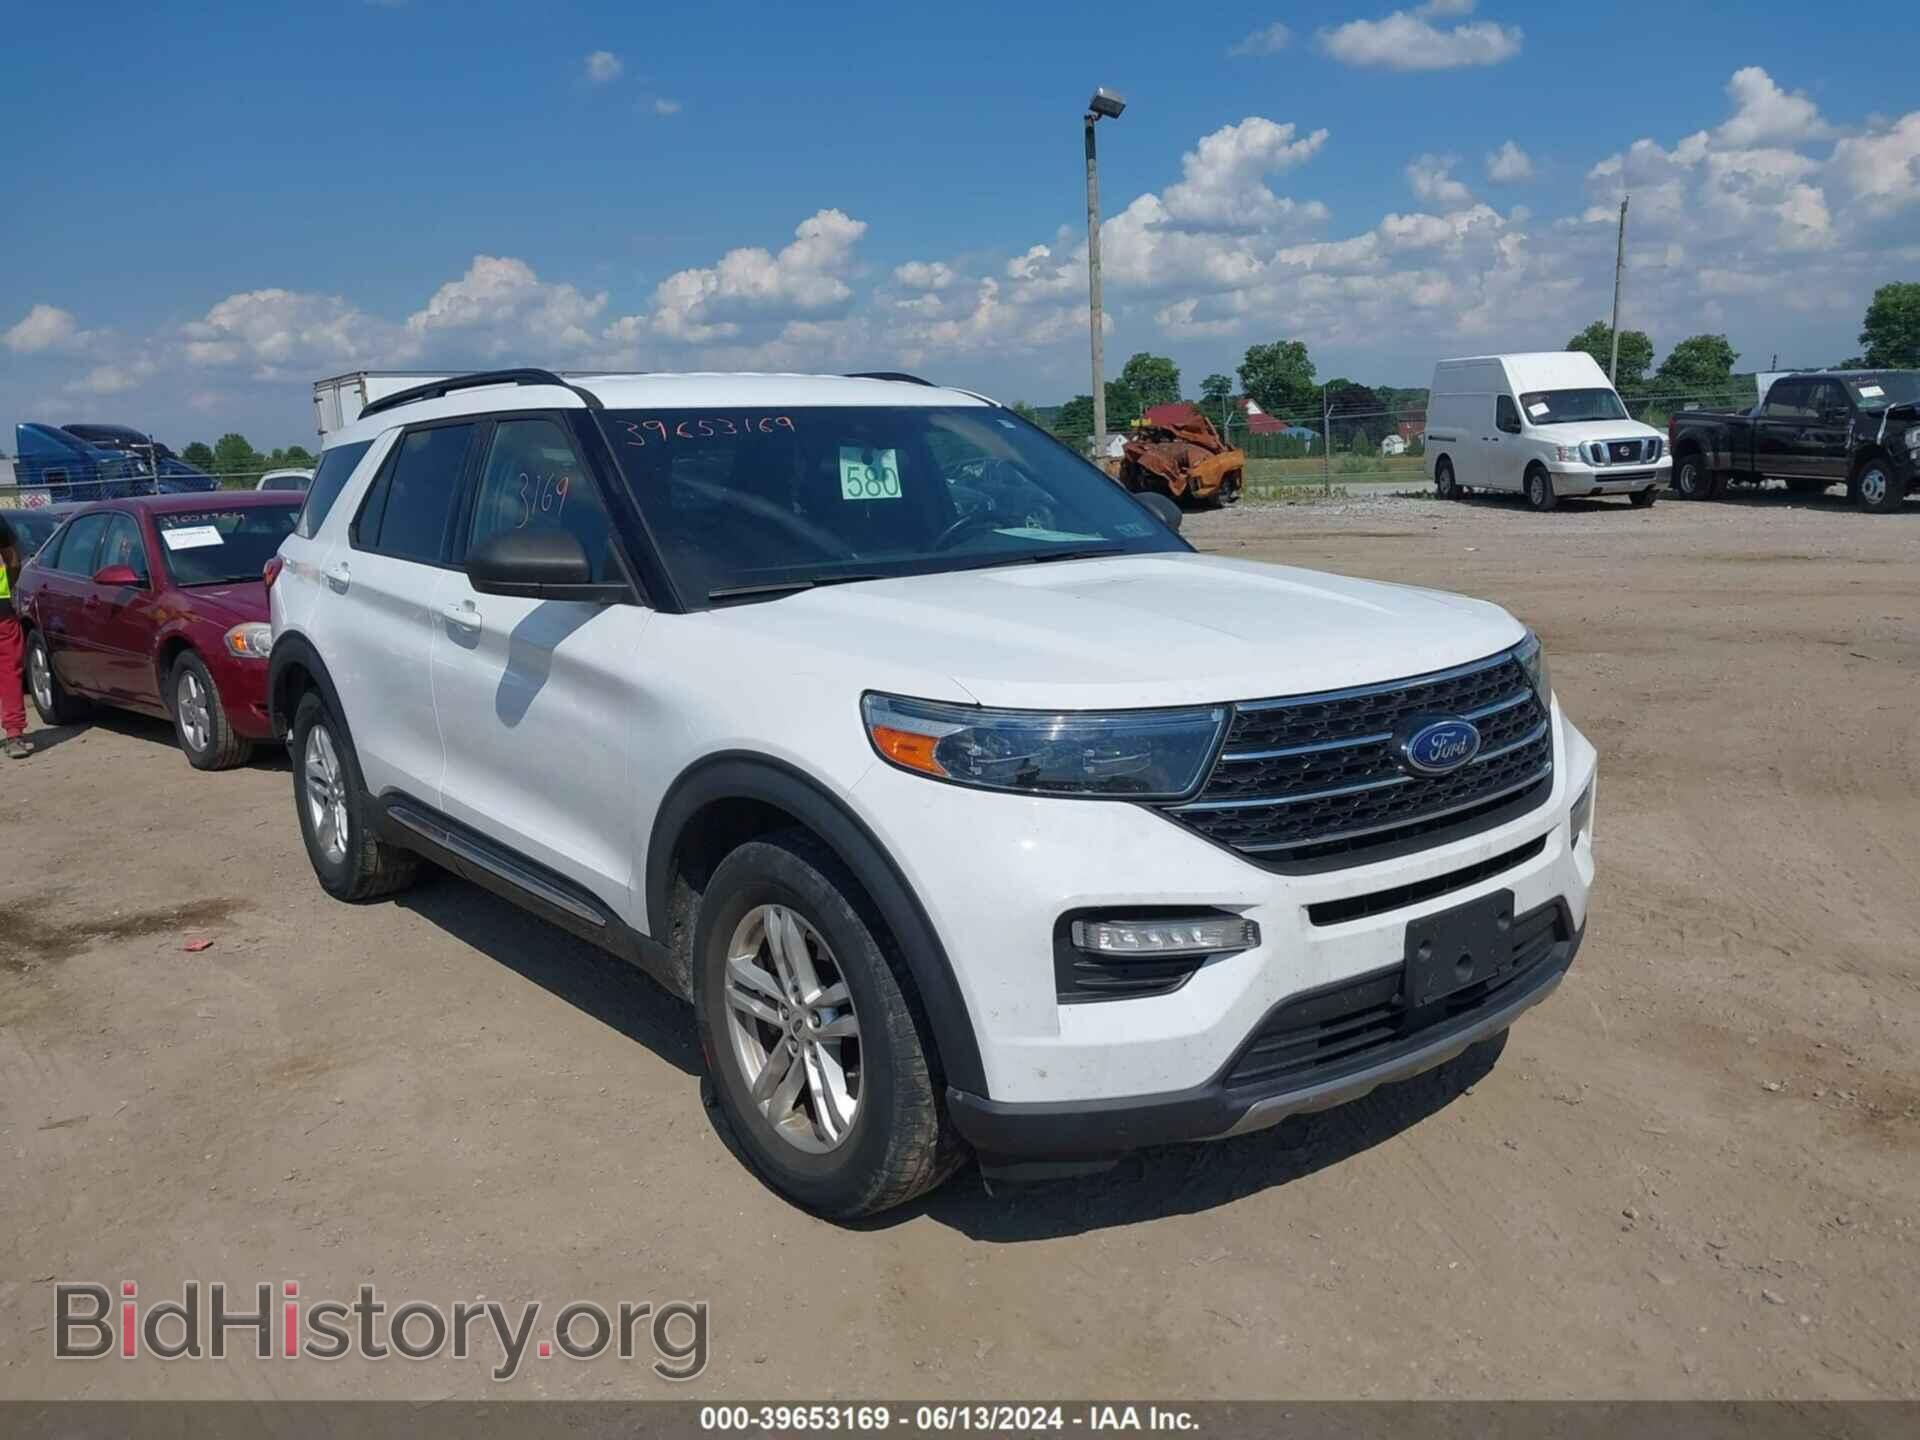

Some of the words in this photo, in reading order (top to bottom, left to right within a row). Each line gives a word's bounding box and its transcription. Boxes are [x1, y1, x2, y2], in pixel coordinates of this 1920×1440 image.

[615, 416, 796, 447] 39653169
[847, 466, 899, 497] 580
[515, 472, 569, 529] 3169
[1430, 731, 1468, 761] Ford
